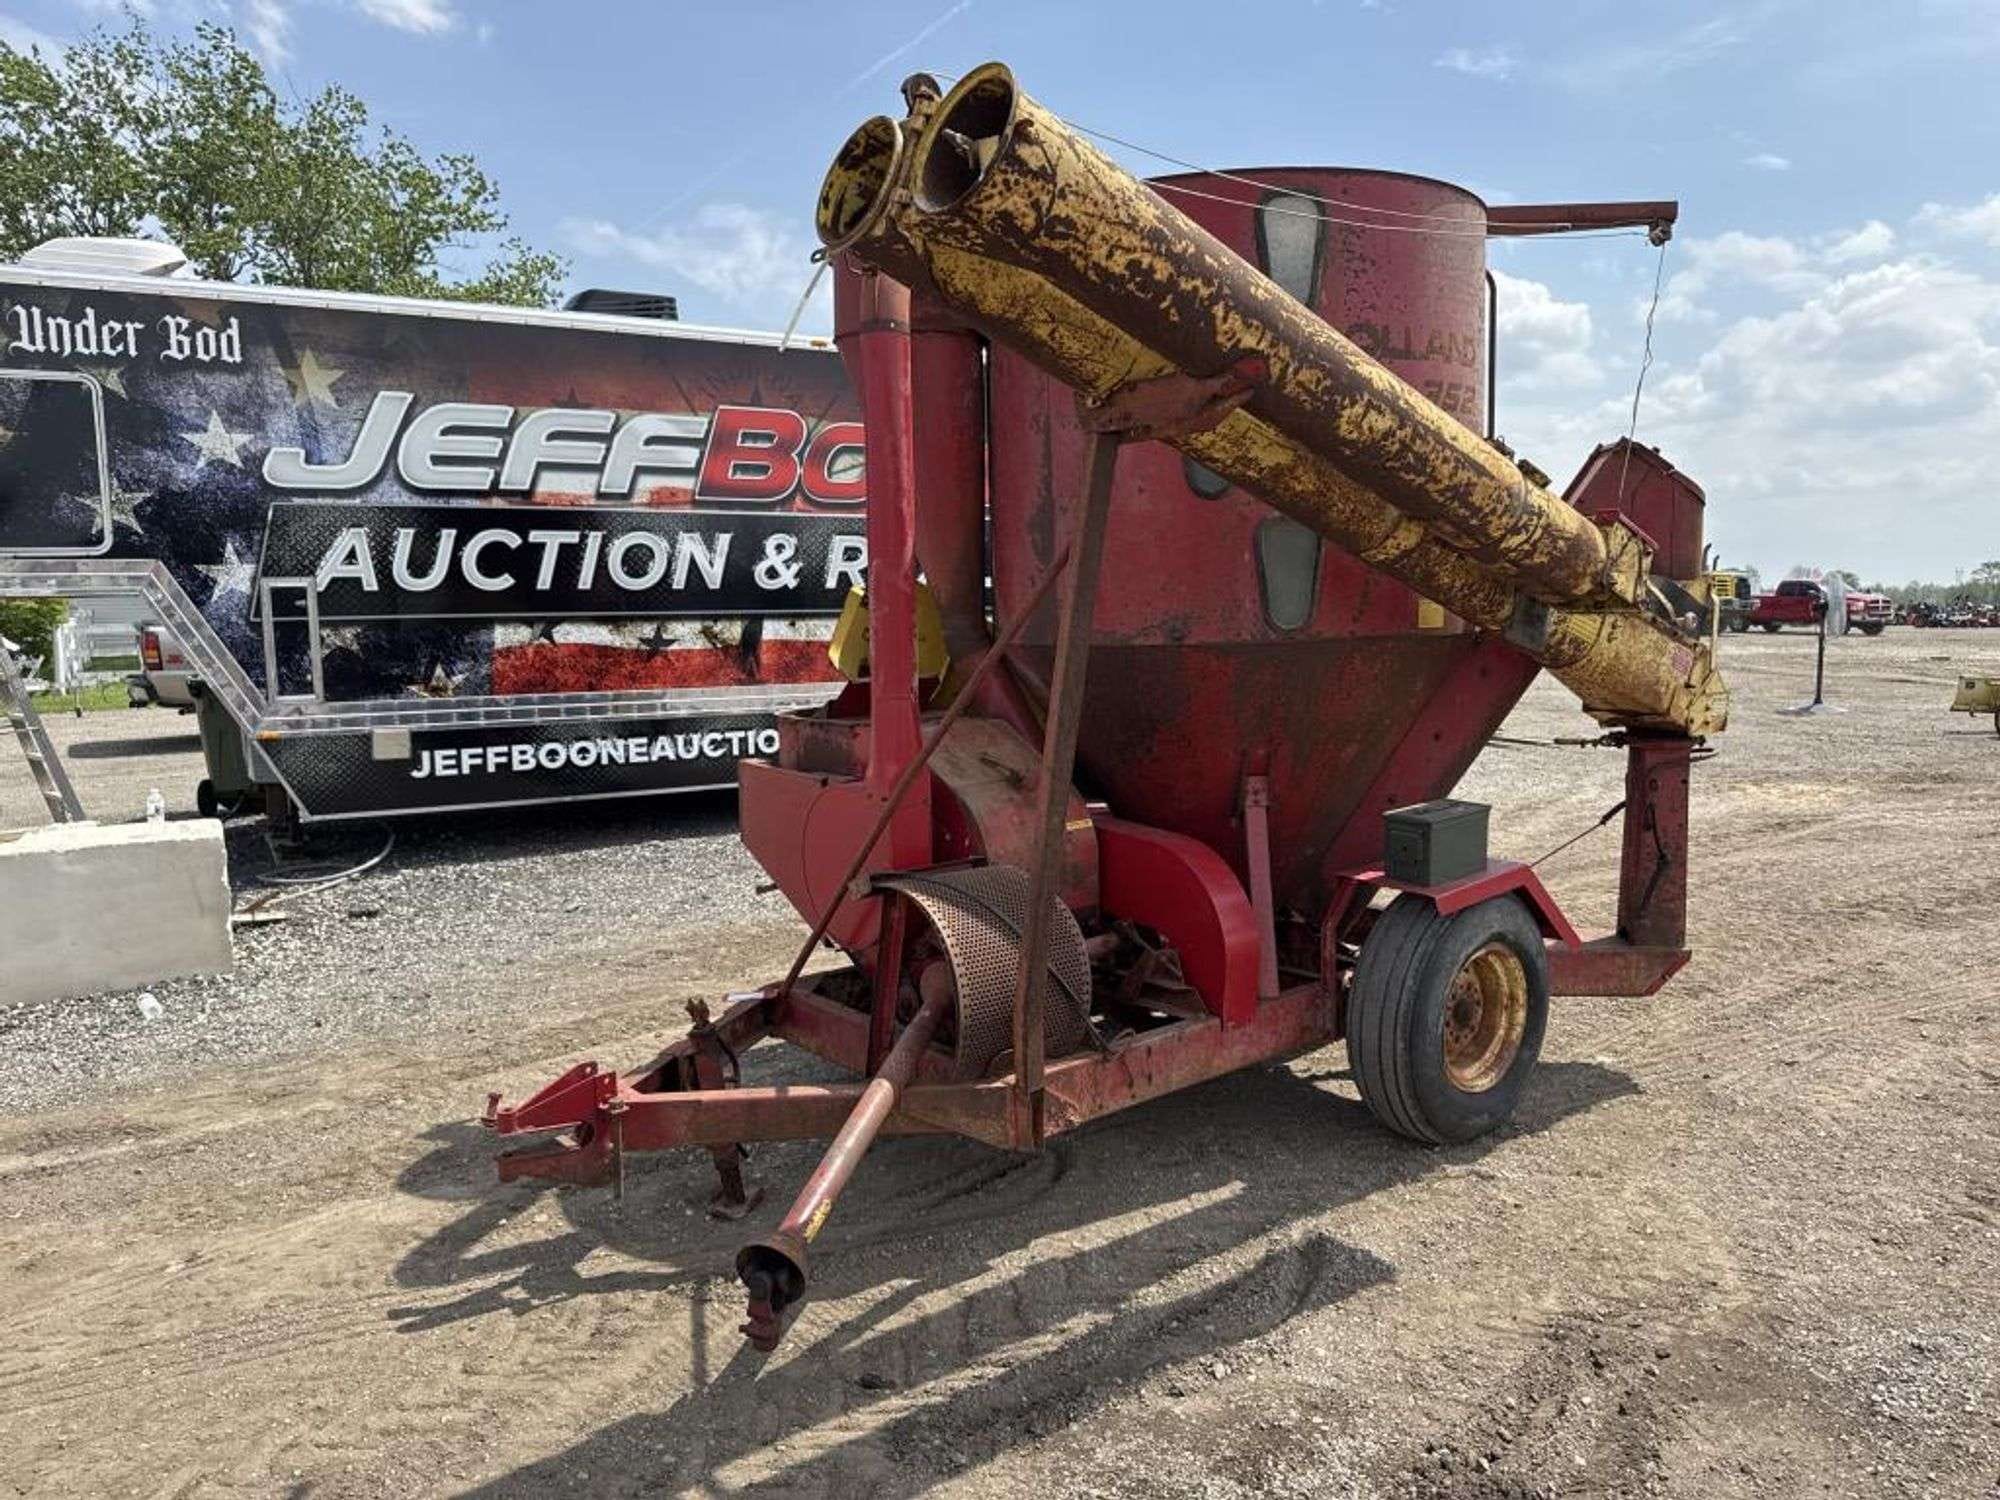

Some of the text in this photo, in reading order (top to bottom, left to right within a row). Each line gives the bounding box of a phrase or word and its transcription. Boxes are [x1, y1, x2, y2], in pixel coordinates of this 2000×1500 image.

[7, 304, 145, 357] Under
[316, 527, 733, 592] AUCTION
[753, 532, 803, 590] &
